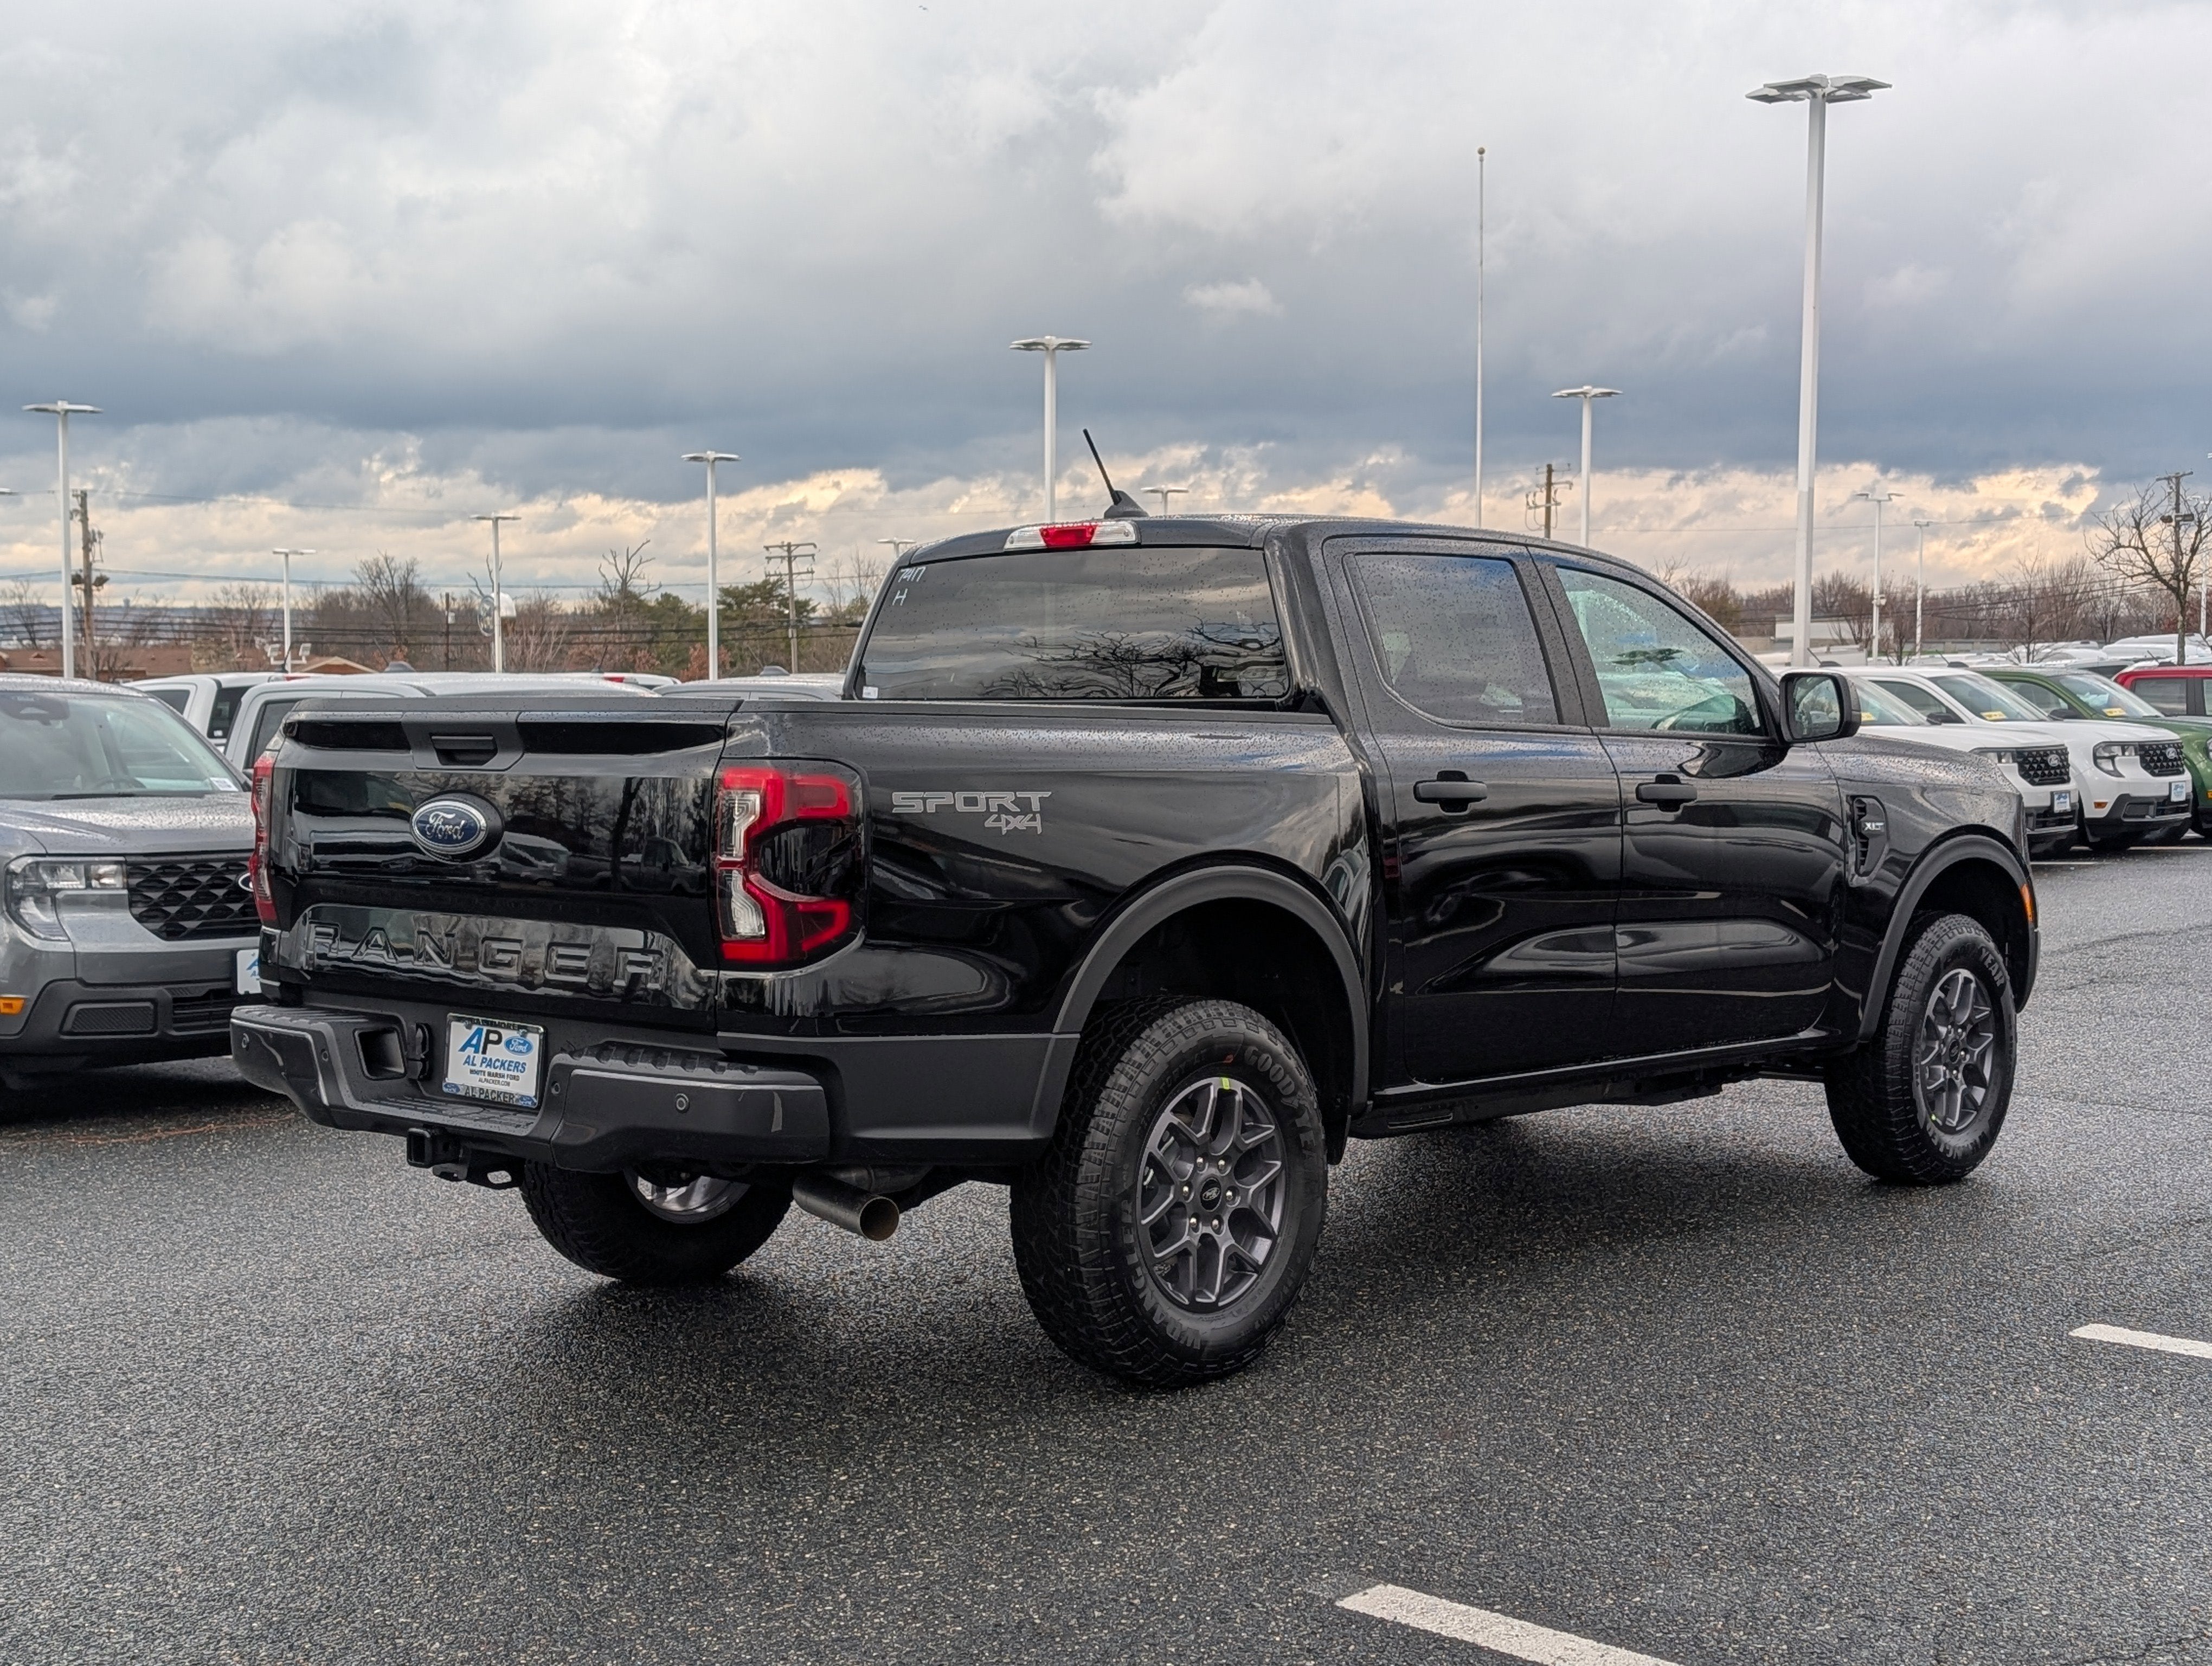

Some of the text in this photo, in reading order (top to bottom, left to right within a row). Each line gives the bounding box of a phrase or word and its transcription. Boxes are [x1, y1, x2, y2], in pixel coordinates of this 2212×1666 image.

[892, 588, 908, 606] H
[892, 792, 1051, 813] SPORT
[426, 811, 465, 840] Ford
[306, 921, 665, 990] RANGER
[458, 1027, 529, 1054] AP Ford
[462, 1055, 526, 1073] AL PACKERS
[478, 1078, 510, 1087] ALPACKER.COM
[465, 1085, 476, 1097] AL
[479, 1087, 515, 1104] PACKER
